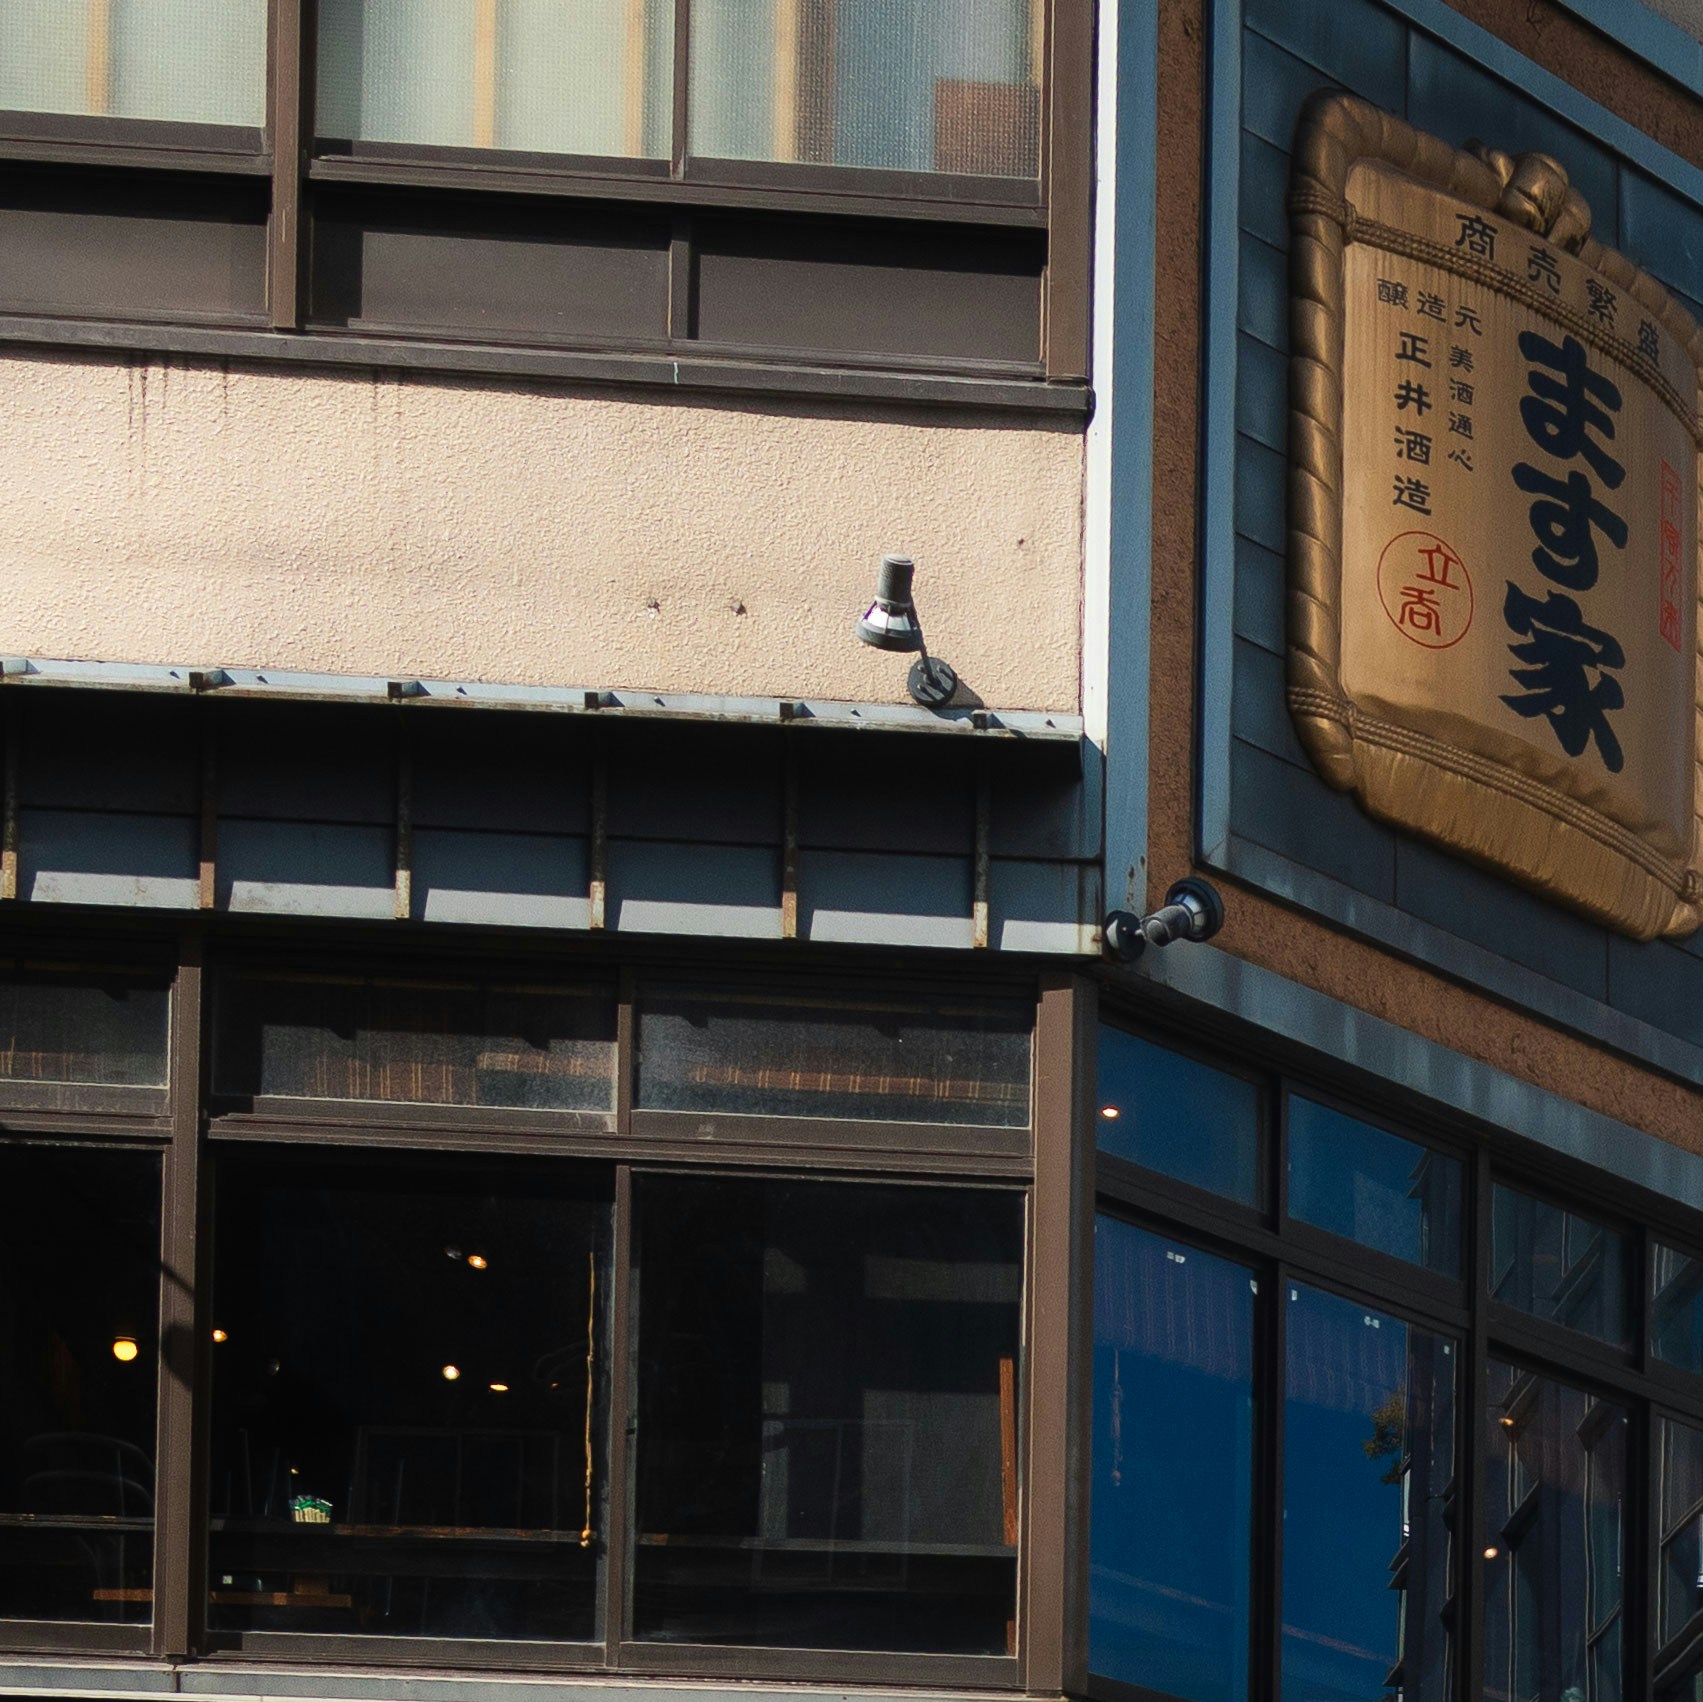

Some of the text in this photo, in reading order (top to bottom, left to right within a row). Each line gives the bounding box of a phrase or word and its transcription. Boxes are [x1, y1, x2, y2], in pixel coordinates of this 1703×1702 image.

[1394, 331, 1433, 516] 正井酒造
[1498, 330, 1628, 773] ます家
